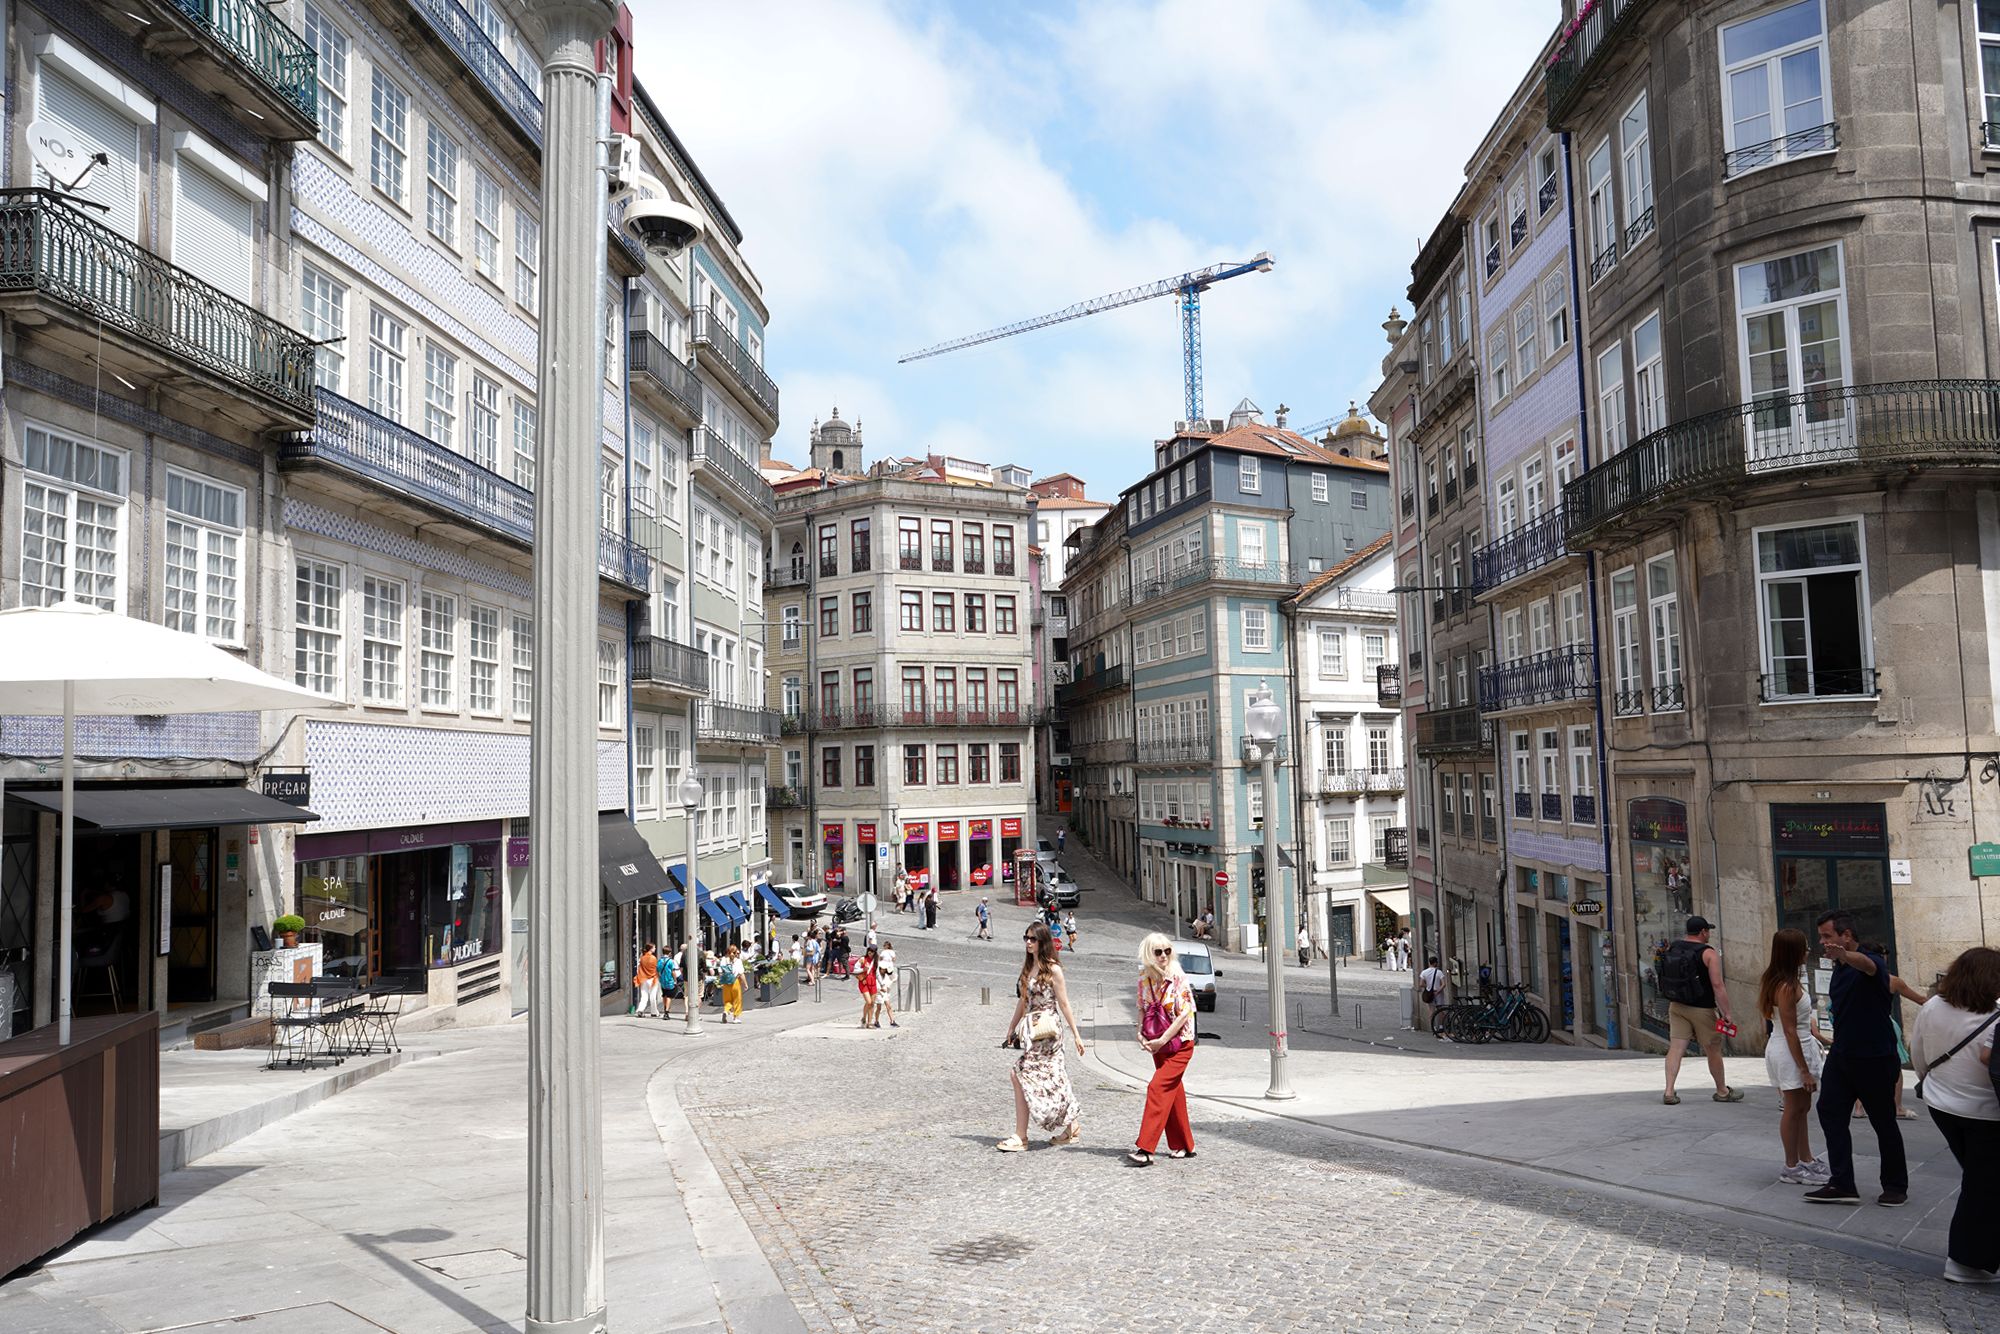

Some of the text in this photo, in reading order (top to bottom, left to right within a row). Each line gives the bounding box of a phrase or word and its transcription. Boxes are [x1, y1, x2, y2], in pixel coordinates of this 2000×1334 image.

[39, 136, 75, 159] NOS
[323, 876, 343, 891] SPA
[319, 908, 346, 921] CAUDALIE
[1575, 903, 1600, 912] TATTOO
